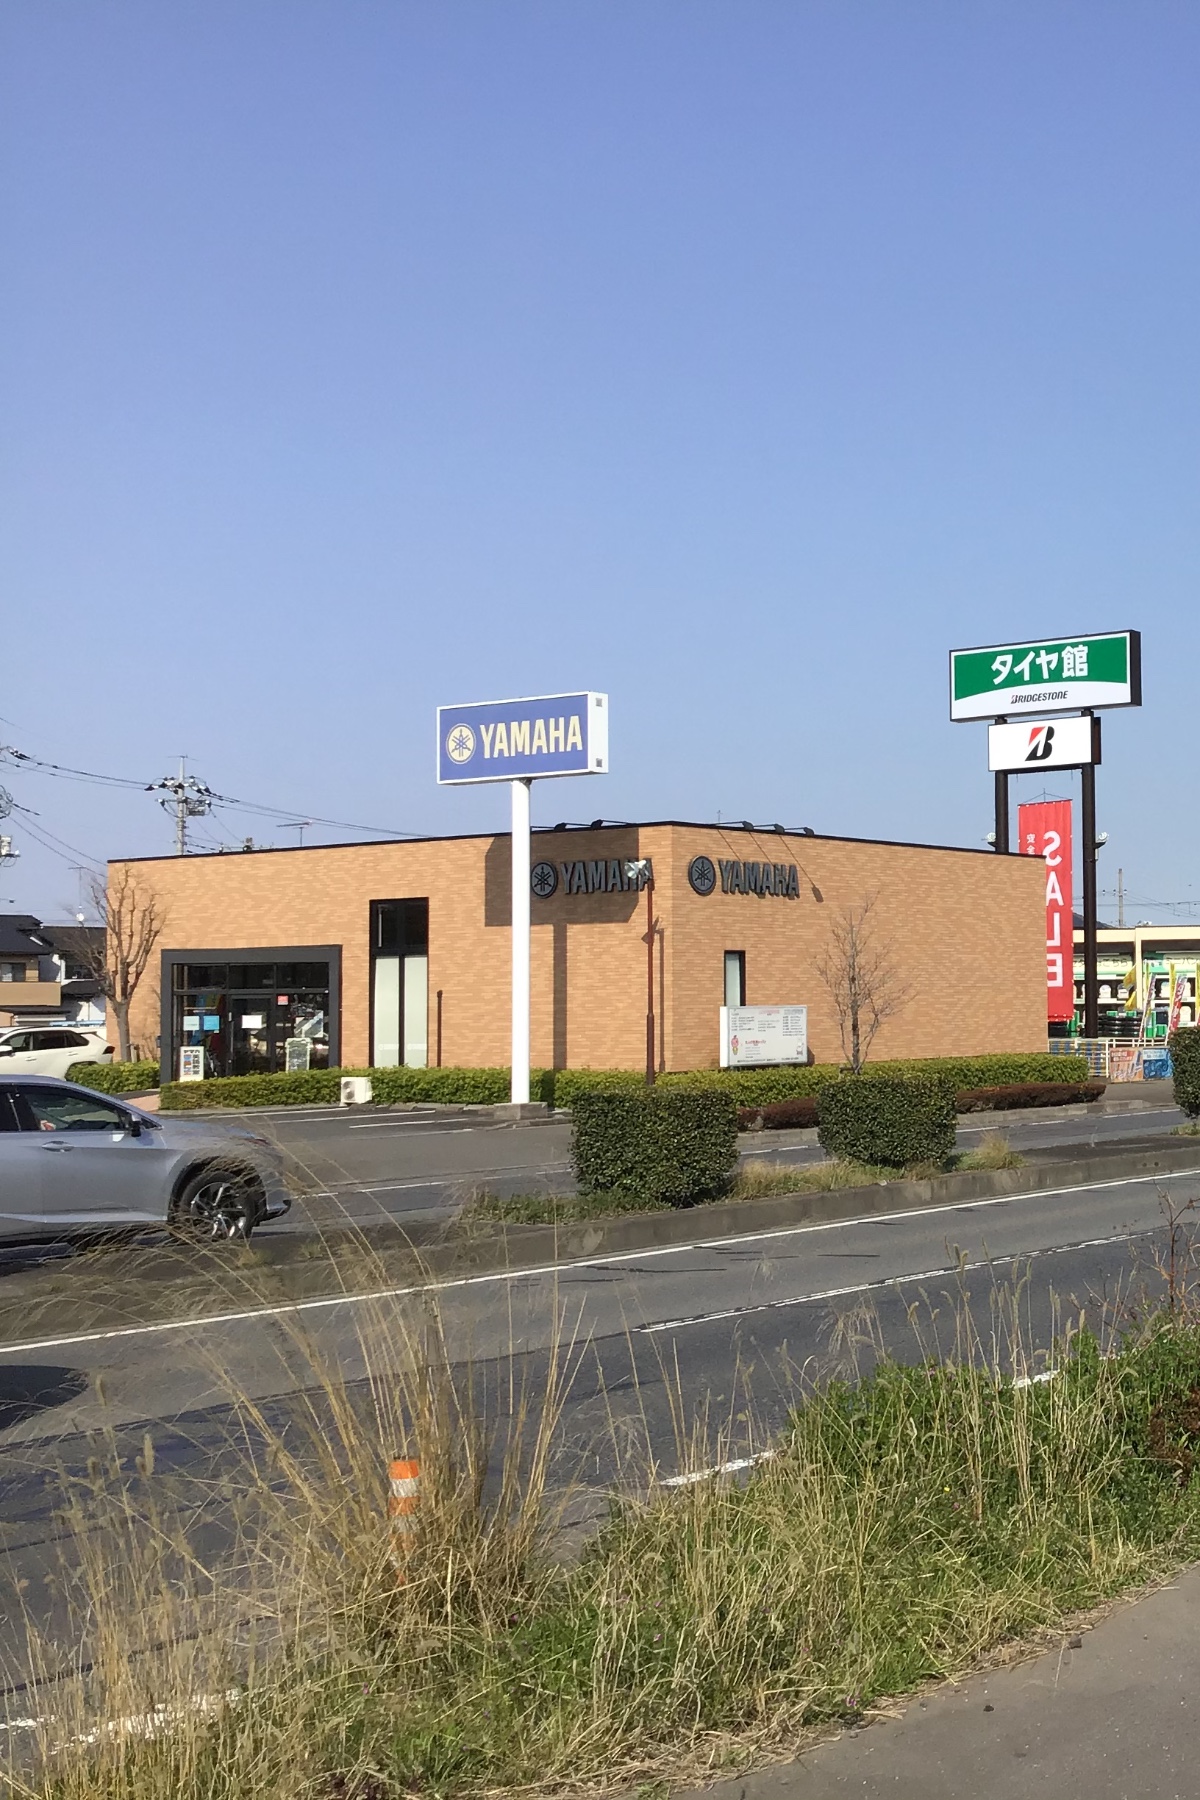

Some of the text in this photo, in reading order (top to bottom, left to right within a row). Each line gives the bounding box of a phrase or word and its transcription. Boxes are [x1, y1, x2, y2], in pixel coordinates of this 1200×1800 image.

[991, 645, 1089, 685] タイヤ館
[1010, 691, 1069, 704] BRIDGESTONE
[480, 715, 583, 759] YAMAHA
[718, 859, 800, 899] YAMAHA
